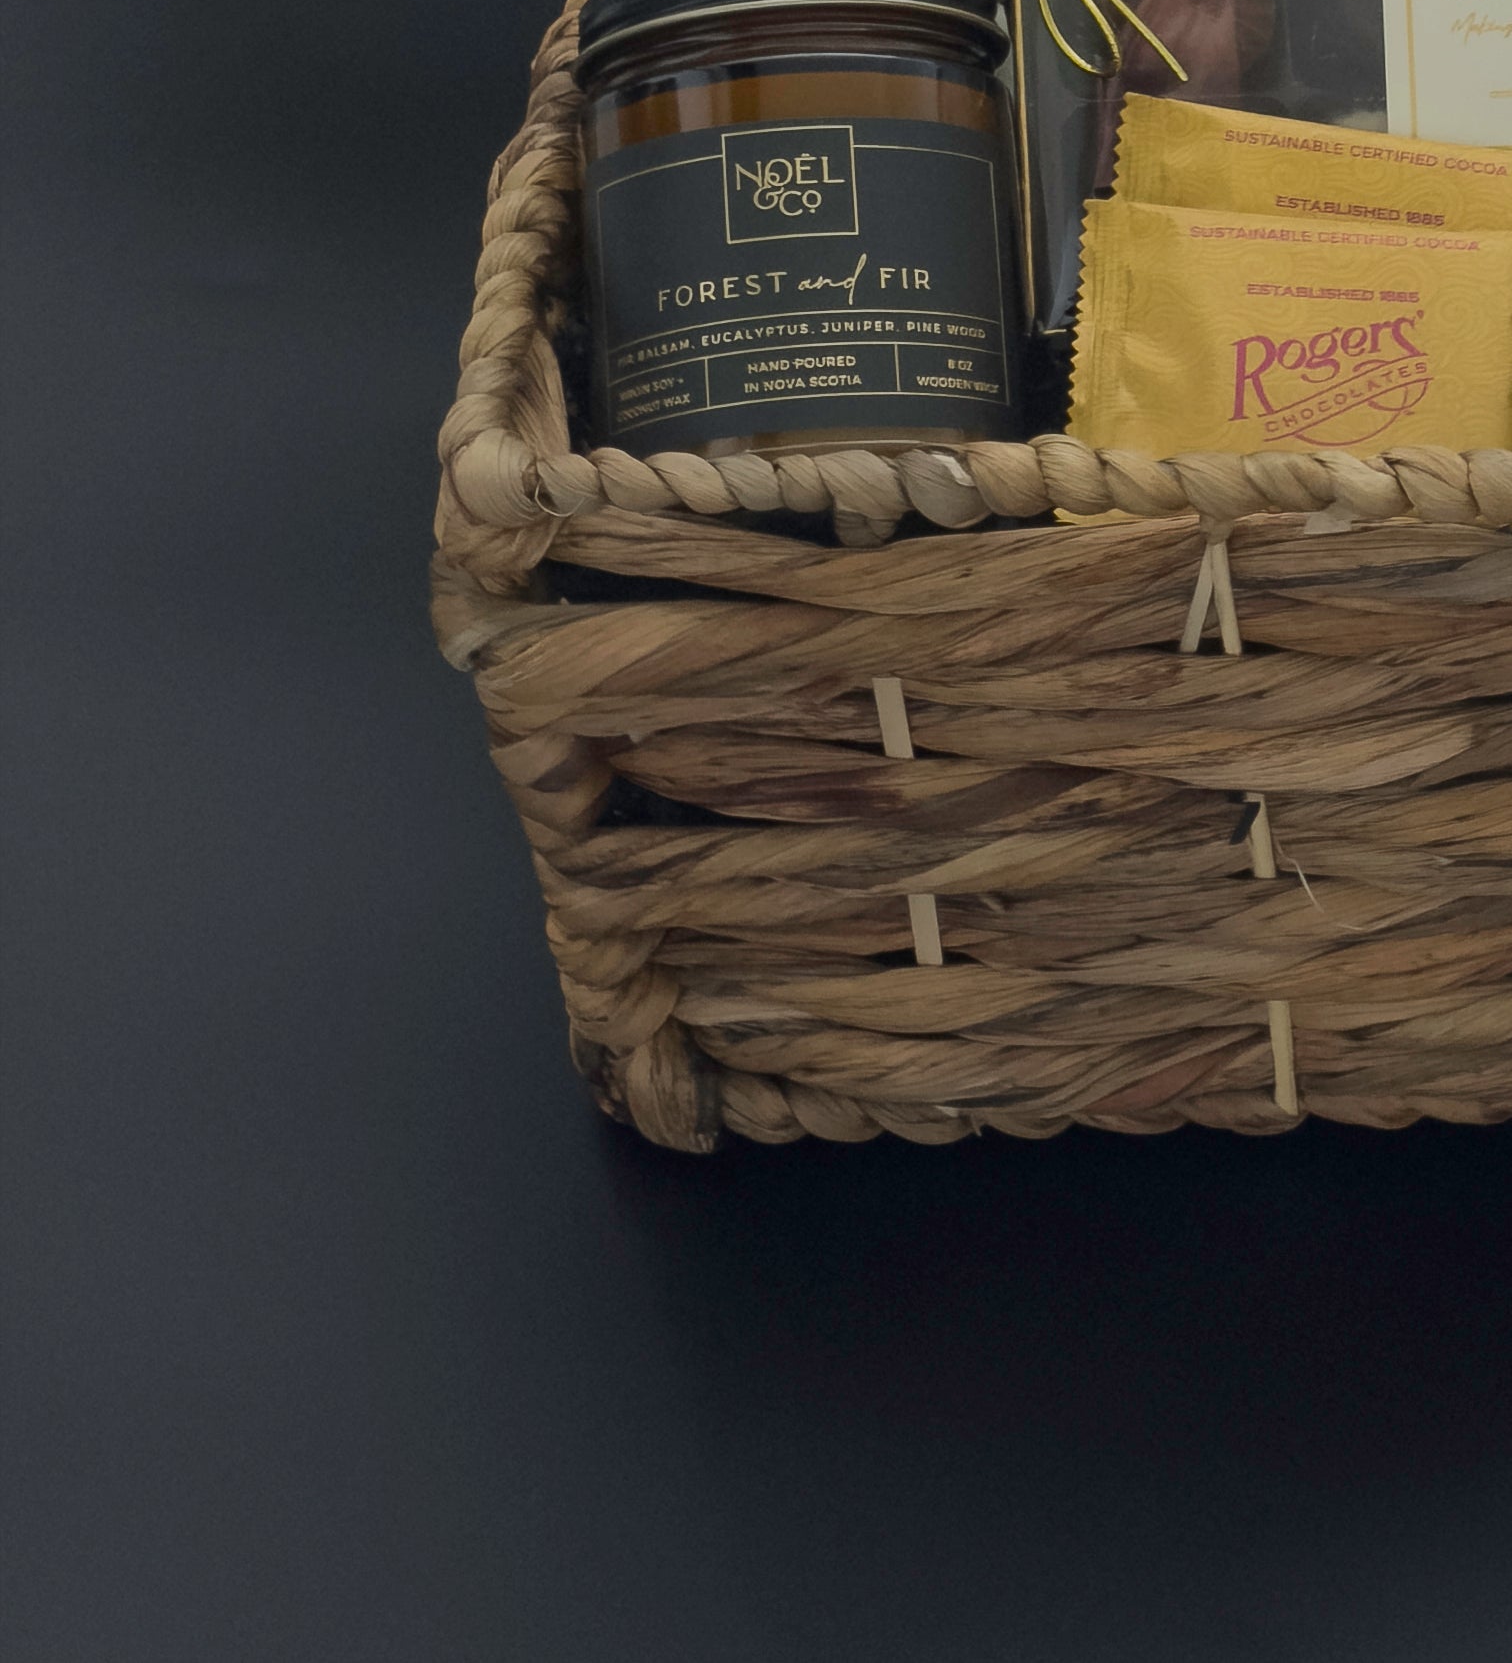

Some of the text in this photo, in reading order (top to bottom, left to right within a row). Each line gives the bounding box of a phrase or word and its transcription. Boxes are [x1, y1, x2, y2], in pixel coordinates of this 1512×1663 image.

[1224, 129, 1509, 177] SUSTAINABLE CERTIFIED COCOA
[1275, 195, 1400, 221] ESTABLISHED
[1189, 225, 1481, 251] SUSTAINABLE CERTIFIED COCOA
[657, 252, 932, 312] FOREST and FIR
[1247, 283, 1375, 302] ESTABLISHED
[906, 321, 942, 334] PINE
[747, 355, 857, 374] HAND POURED
[744, 374, 862, 394] IN NOVA SCOTIA
[916, 375, 972, 391] WOODEN
[1264, 360, 1428, 433] CHOCOLATES
